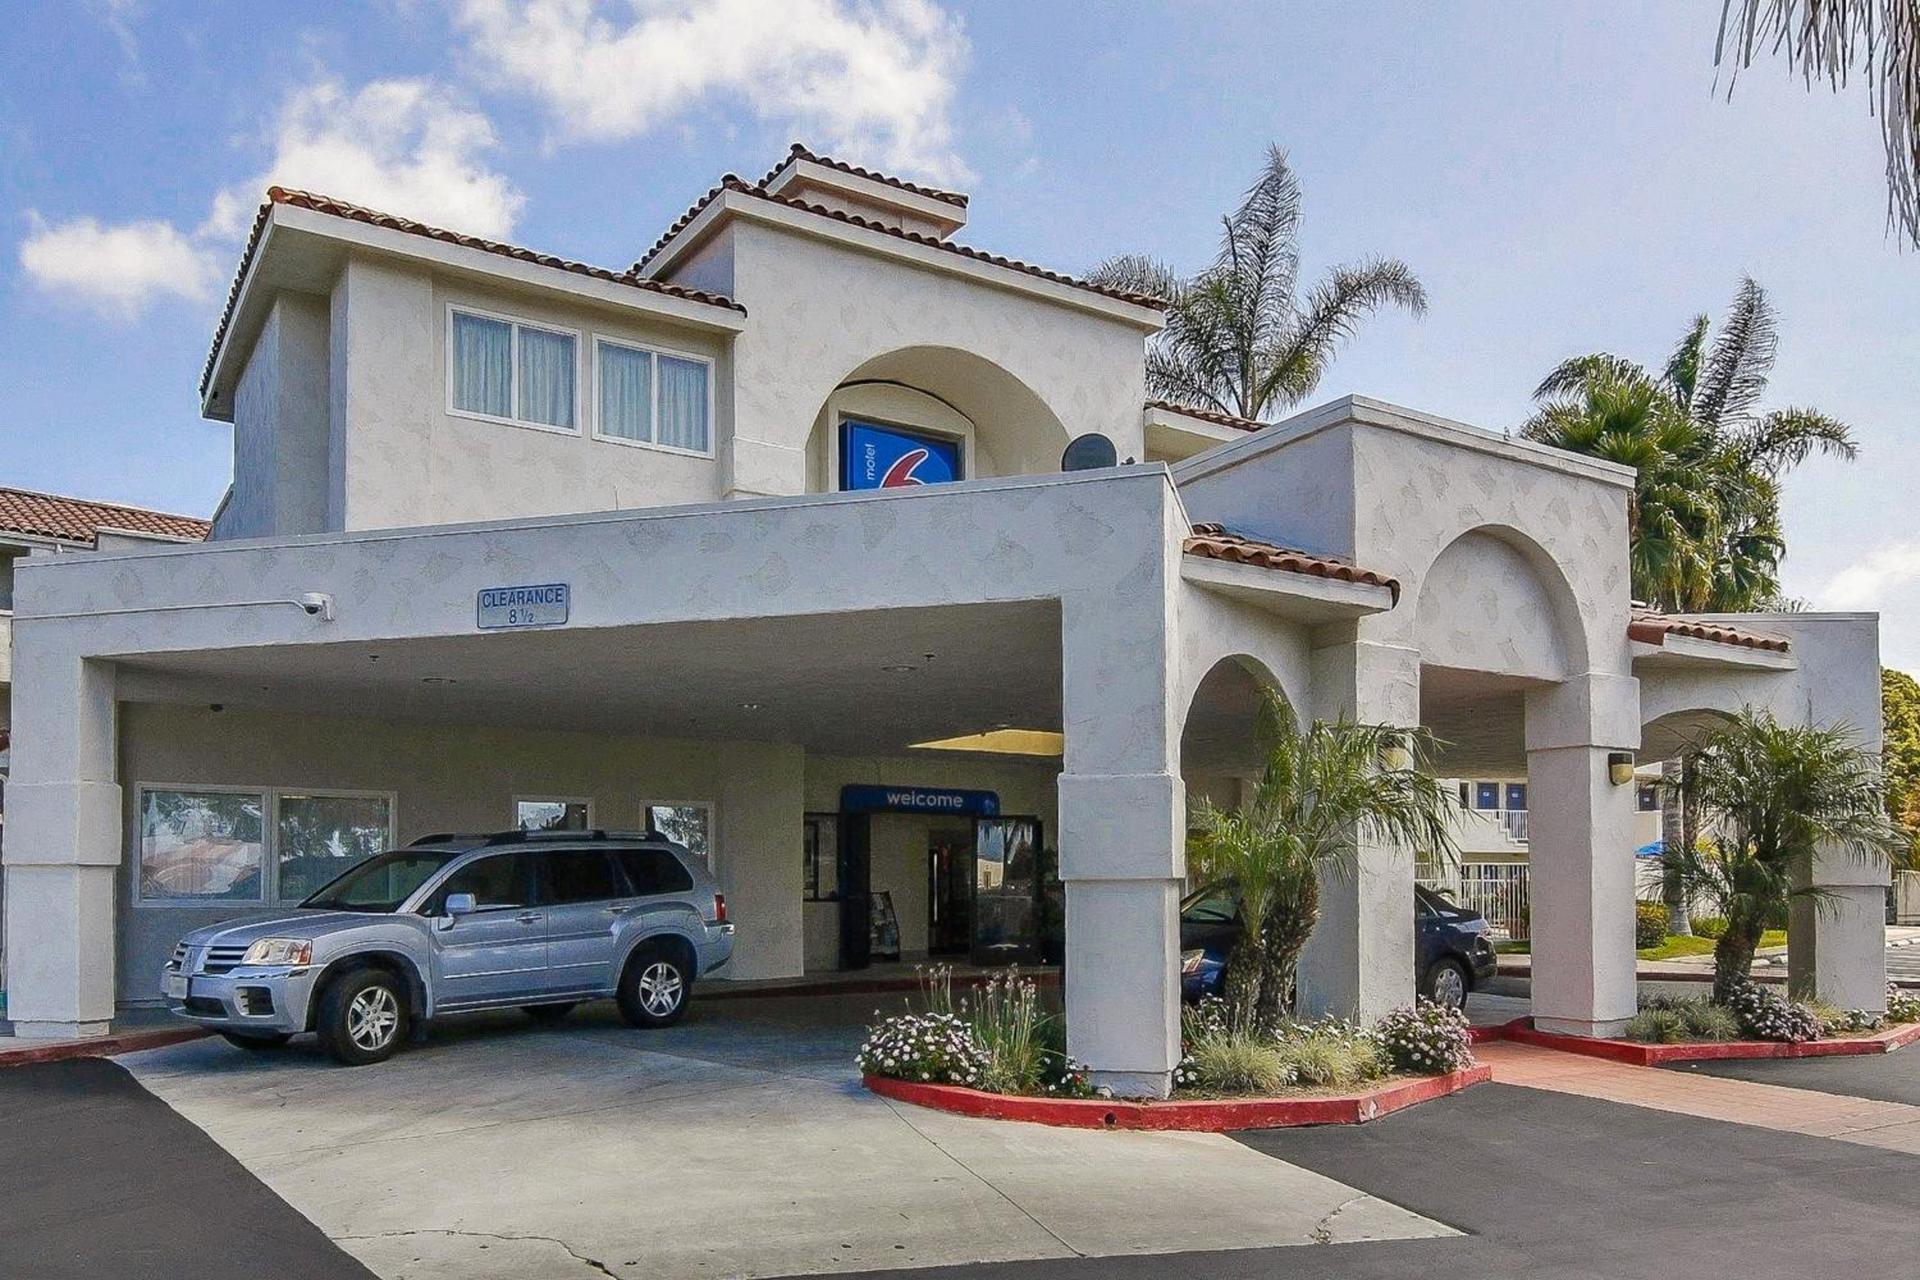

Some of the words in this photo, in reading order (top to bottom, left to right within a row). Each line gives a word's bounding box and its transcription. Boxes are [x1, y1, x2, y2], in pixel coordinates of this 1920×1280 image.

[864, 443, 876, 481] motel
[482, 588, 564, 608] CLEARANCE
[887, 790, 964, 807] welcome
